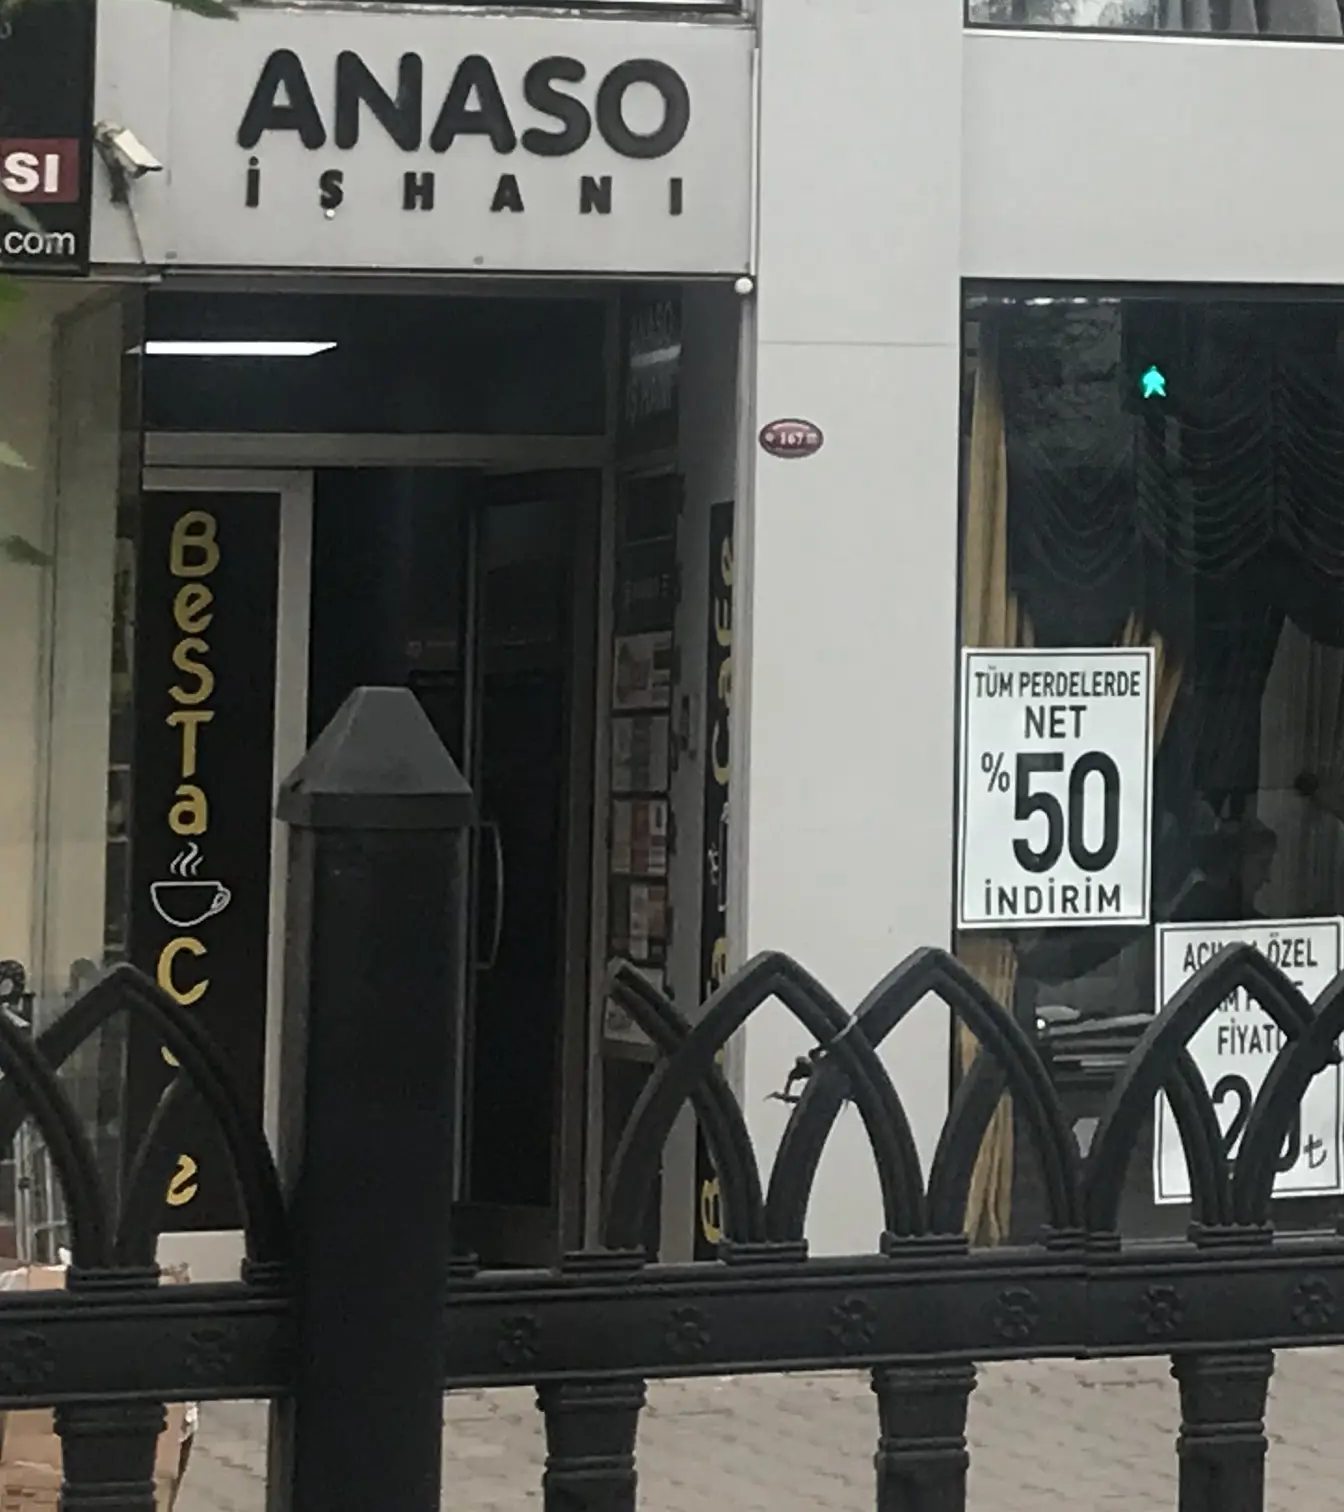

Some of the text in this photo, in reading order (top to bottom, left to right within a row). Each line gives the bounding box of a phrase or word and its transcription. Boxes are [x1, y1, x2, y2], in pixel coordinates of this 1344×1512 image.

[237, 47, 691, 160] ANASO
[974, 664, 1142, 698] TÜM PERDELERDE
[1023, 704, 1088, 739] NET
[984, 877, 1122, 916] İNDİRİM
[1267, 932, 1319, 968] ÖZEL
